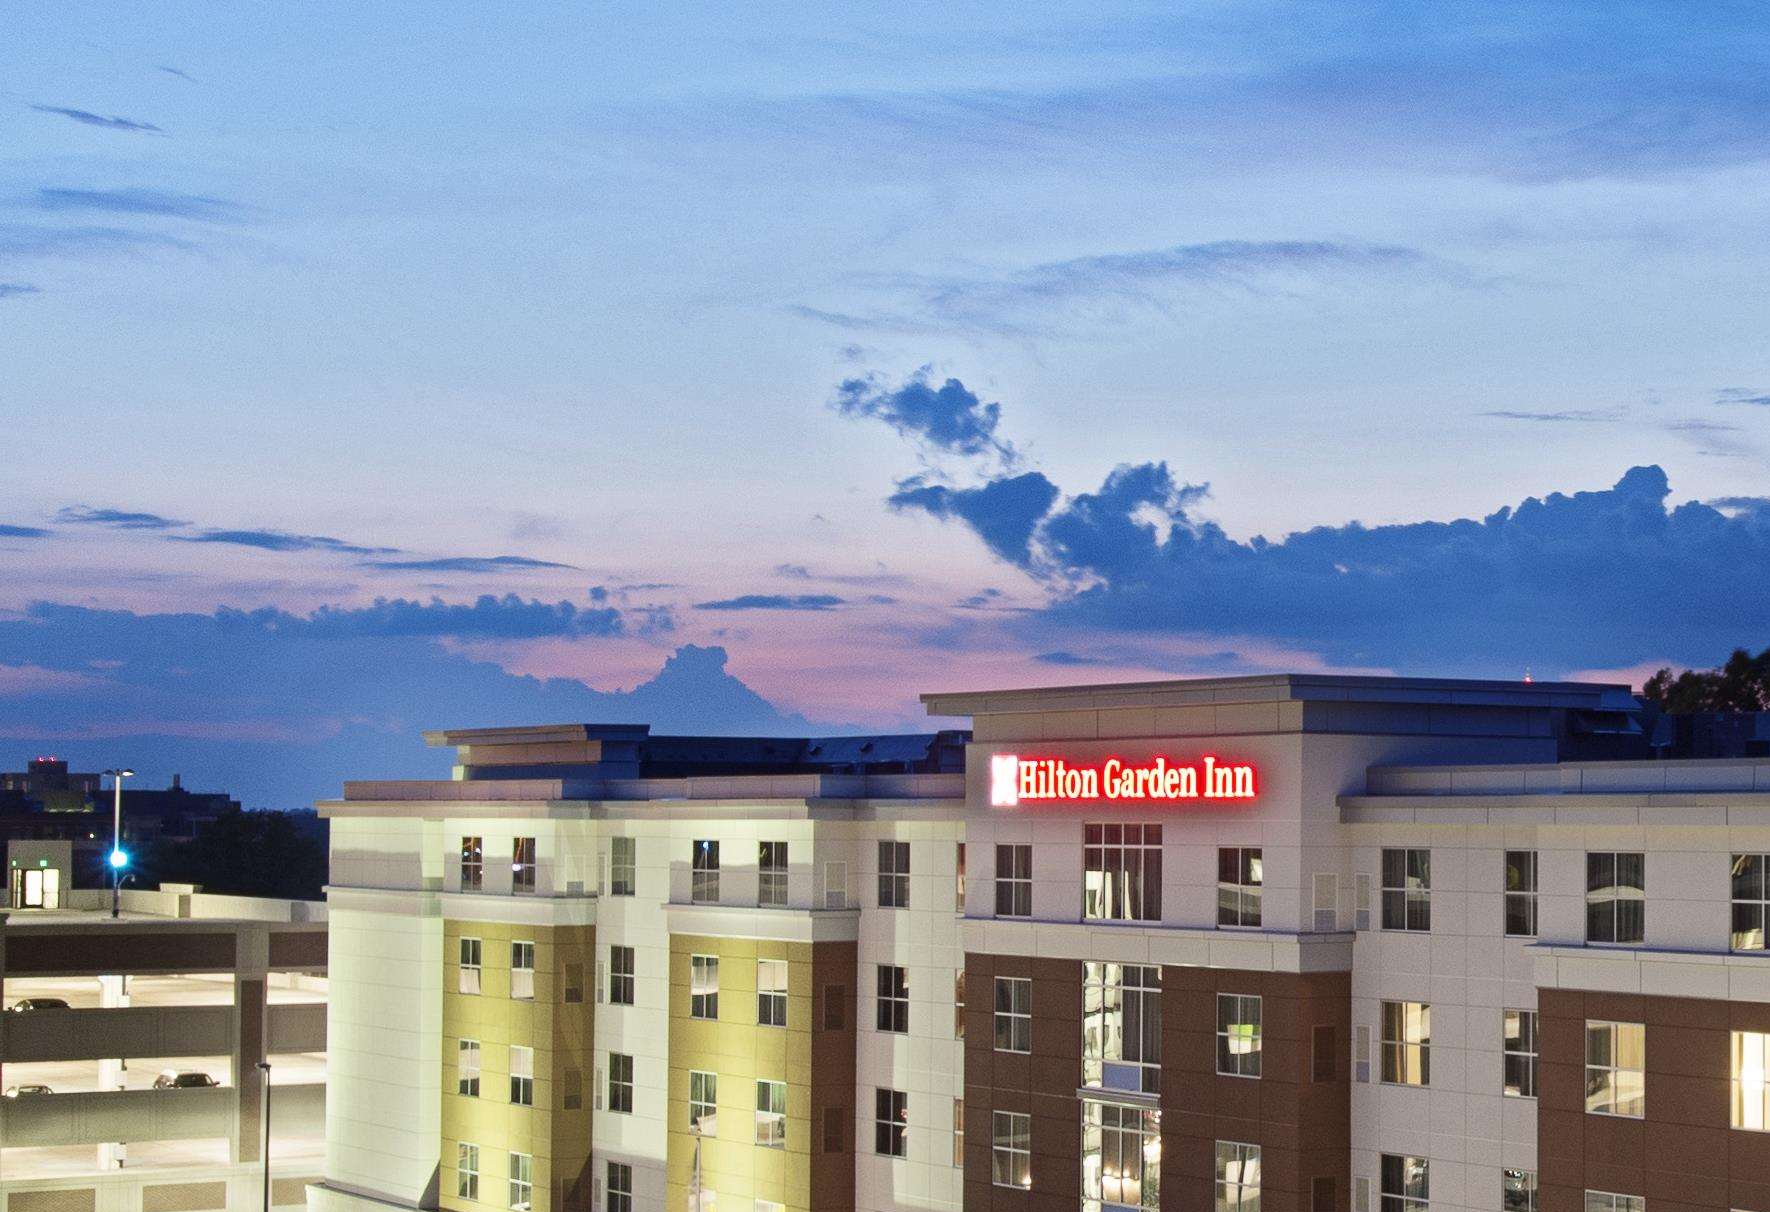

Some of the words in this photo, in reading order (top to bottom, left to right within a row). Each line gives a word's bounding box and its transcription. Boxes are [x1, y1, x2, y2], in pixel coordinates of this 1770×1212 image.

[1018, 759, 1098, 799] Hilton
[1104, 757, 1198, 799] Garden
[1204, 756, 1255, 798] Inn
